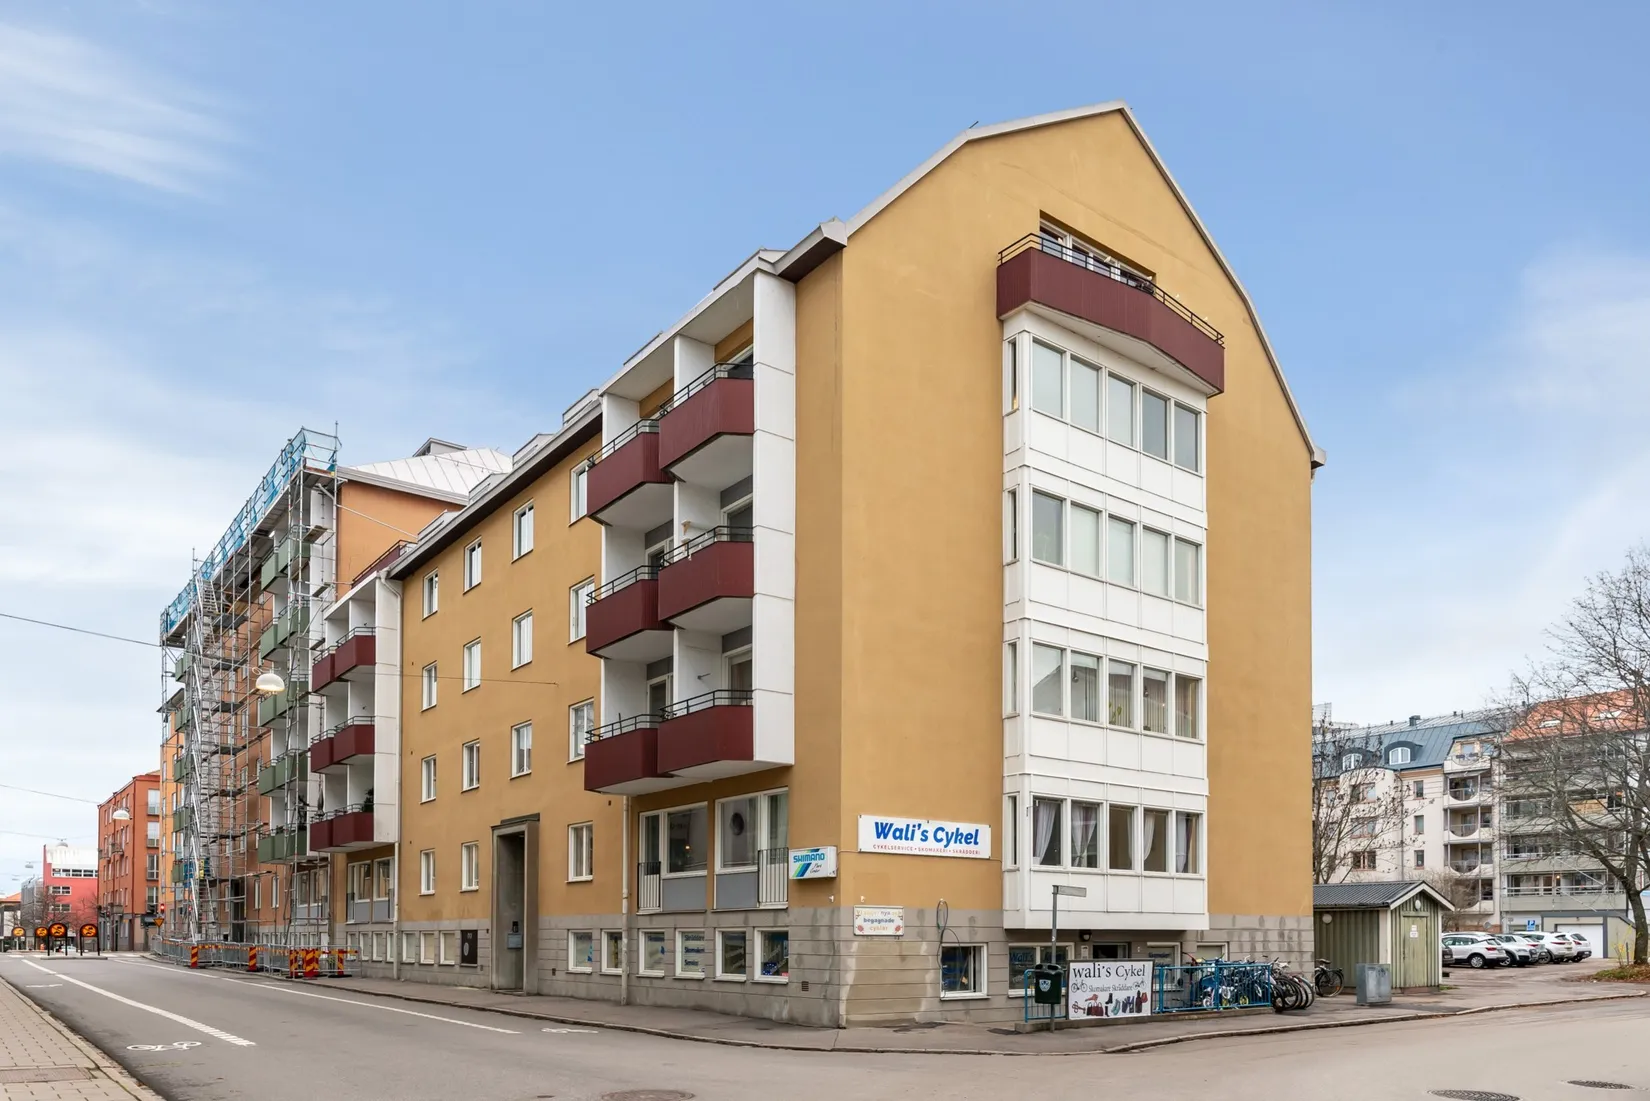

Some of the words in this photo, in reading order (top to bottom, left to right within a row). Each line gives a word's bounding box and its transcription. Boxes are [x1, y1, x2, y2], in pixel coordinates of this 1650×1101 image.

[874, 821, 929, 842] Wali's
[933, 826, 979, 848] Cykel
[793, 852, 825, 863] SHIMANO
[1072, 962, 1112, 979] wali's
[1115, 964, 1146, 980] Cykel
